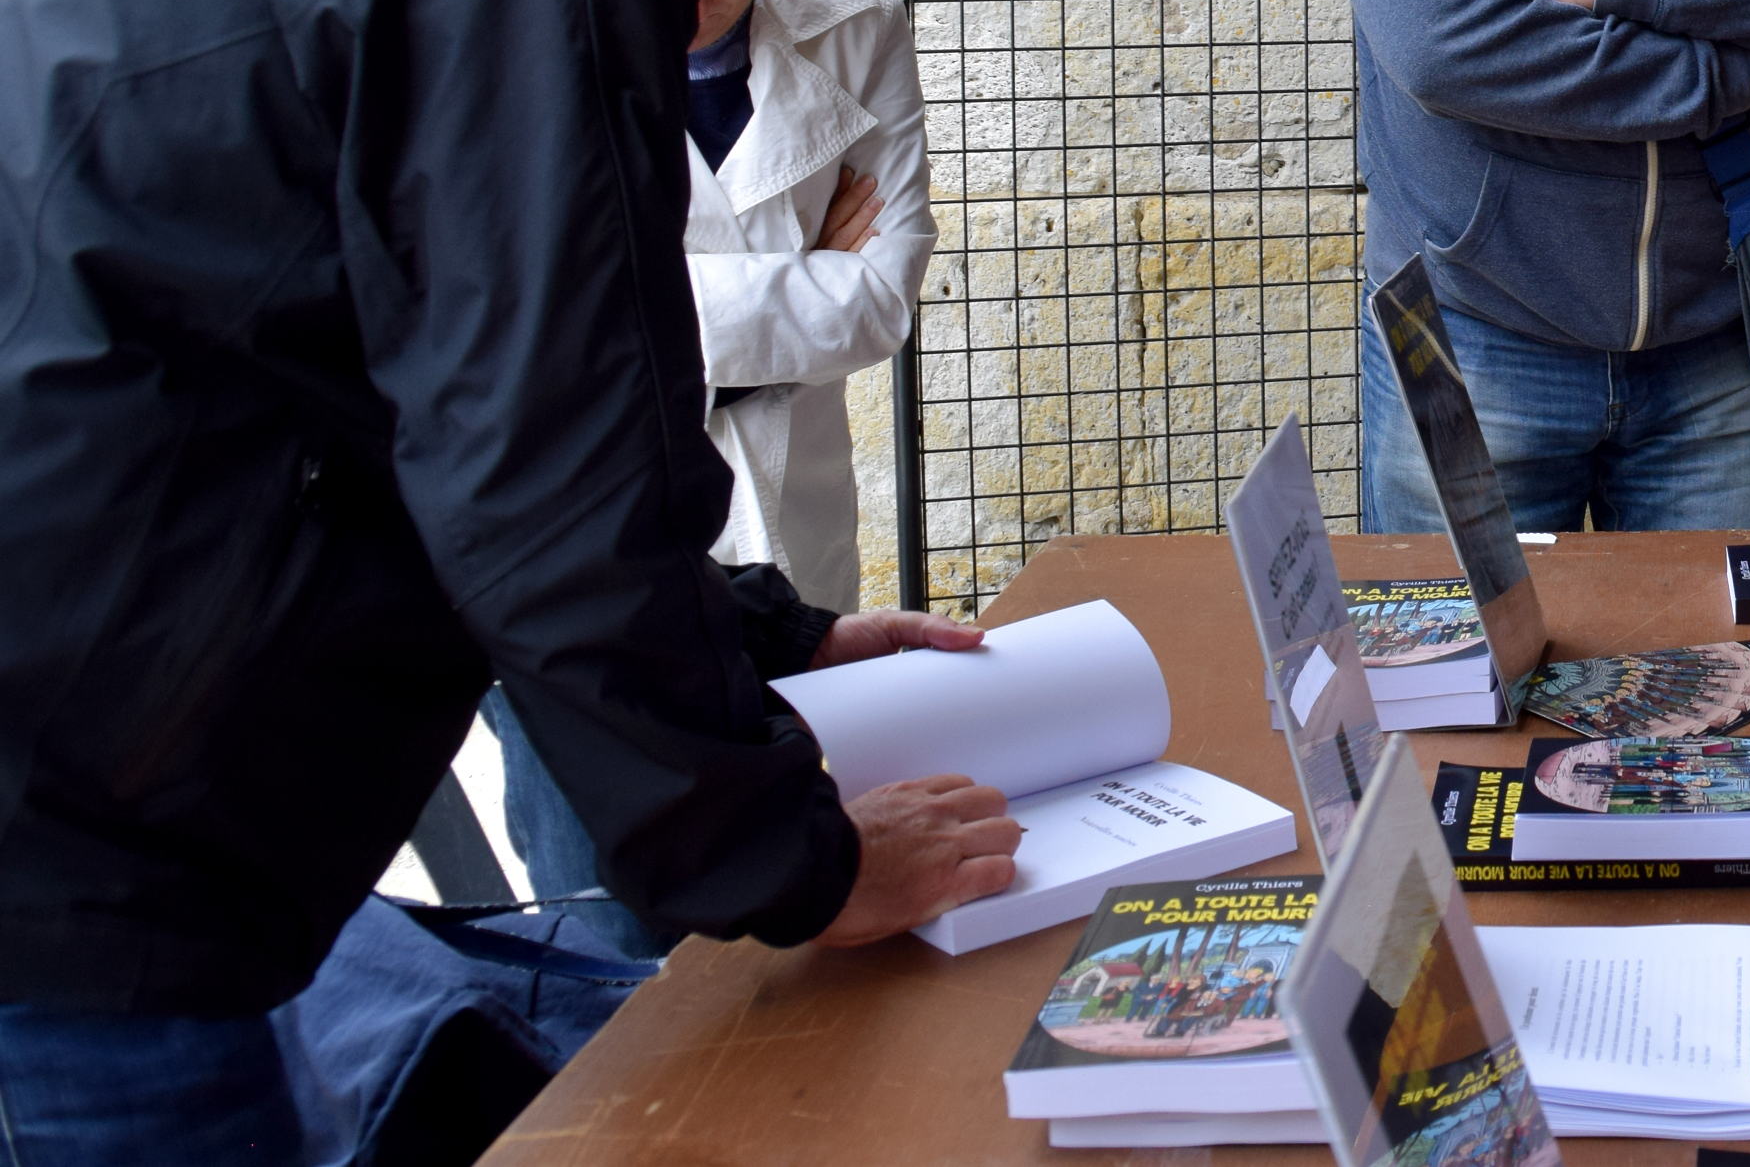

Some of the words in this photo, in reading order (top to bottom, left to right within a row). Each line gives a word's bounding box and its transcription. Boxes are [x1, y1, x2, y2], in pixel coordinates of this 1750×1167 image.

[1390, 586, 1446, 594] TOUTE
[1479, 771, 1502, 784] VIE
[1476, 786, 1500, 797] LA
[1090, 792, 1125, 808] POUR
[1132, 791, 1169, 811] TOUTE
[1164, 805, 1185, 818] LA
[1183, 814, 1207, 827] VIE
[1471, 798, 1498, 825] TOUTE
[1466, 836, 1491, 851] ON
[1508, 865, 1545, 879] POUR
[1549, 865, 1570, 879] VIE
[1577, 865, 1593, 879] LA
[1597, 864, 1640, 878] TOUTE
[1645, 864, 1653, 878] A
[1659, 864, 1680, 877] ON
[1195, 882, 1248, 892] Cyrille
[1252, 880, 1303, 889] Thiers
[1112, 900, 1154, 915] ON
[1163, 898, 1183, 911] A
[1195, 895, 1276, 909] TOUTE
[1284, 893, 1319, 906] LA
[1144, 909, 1215, 925] POUR
[1226, 907, 1314, 921] MOURI
